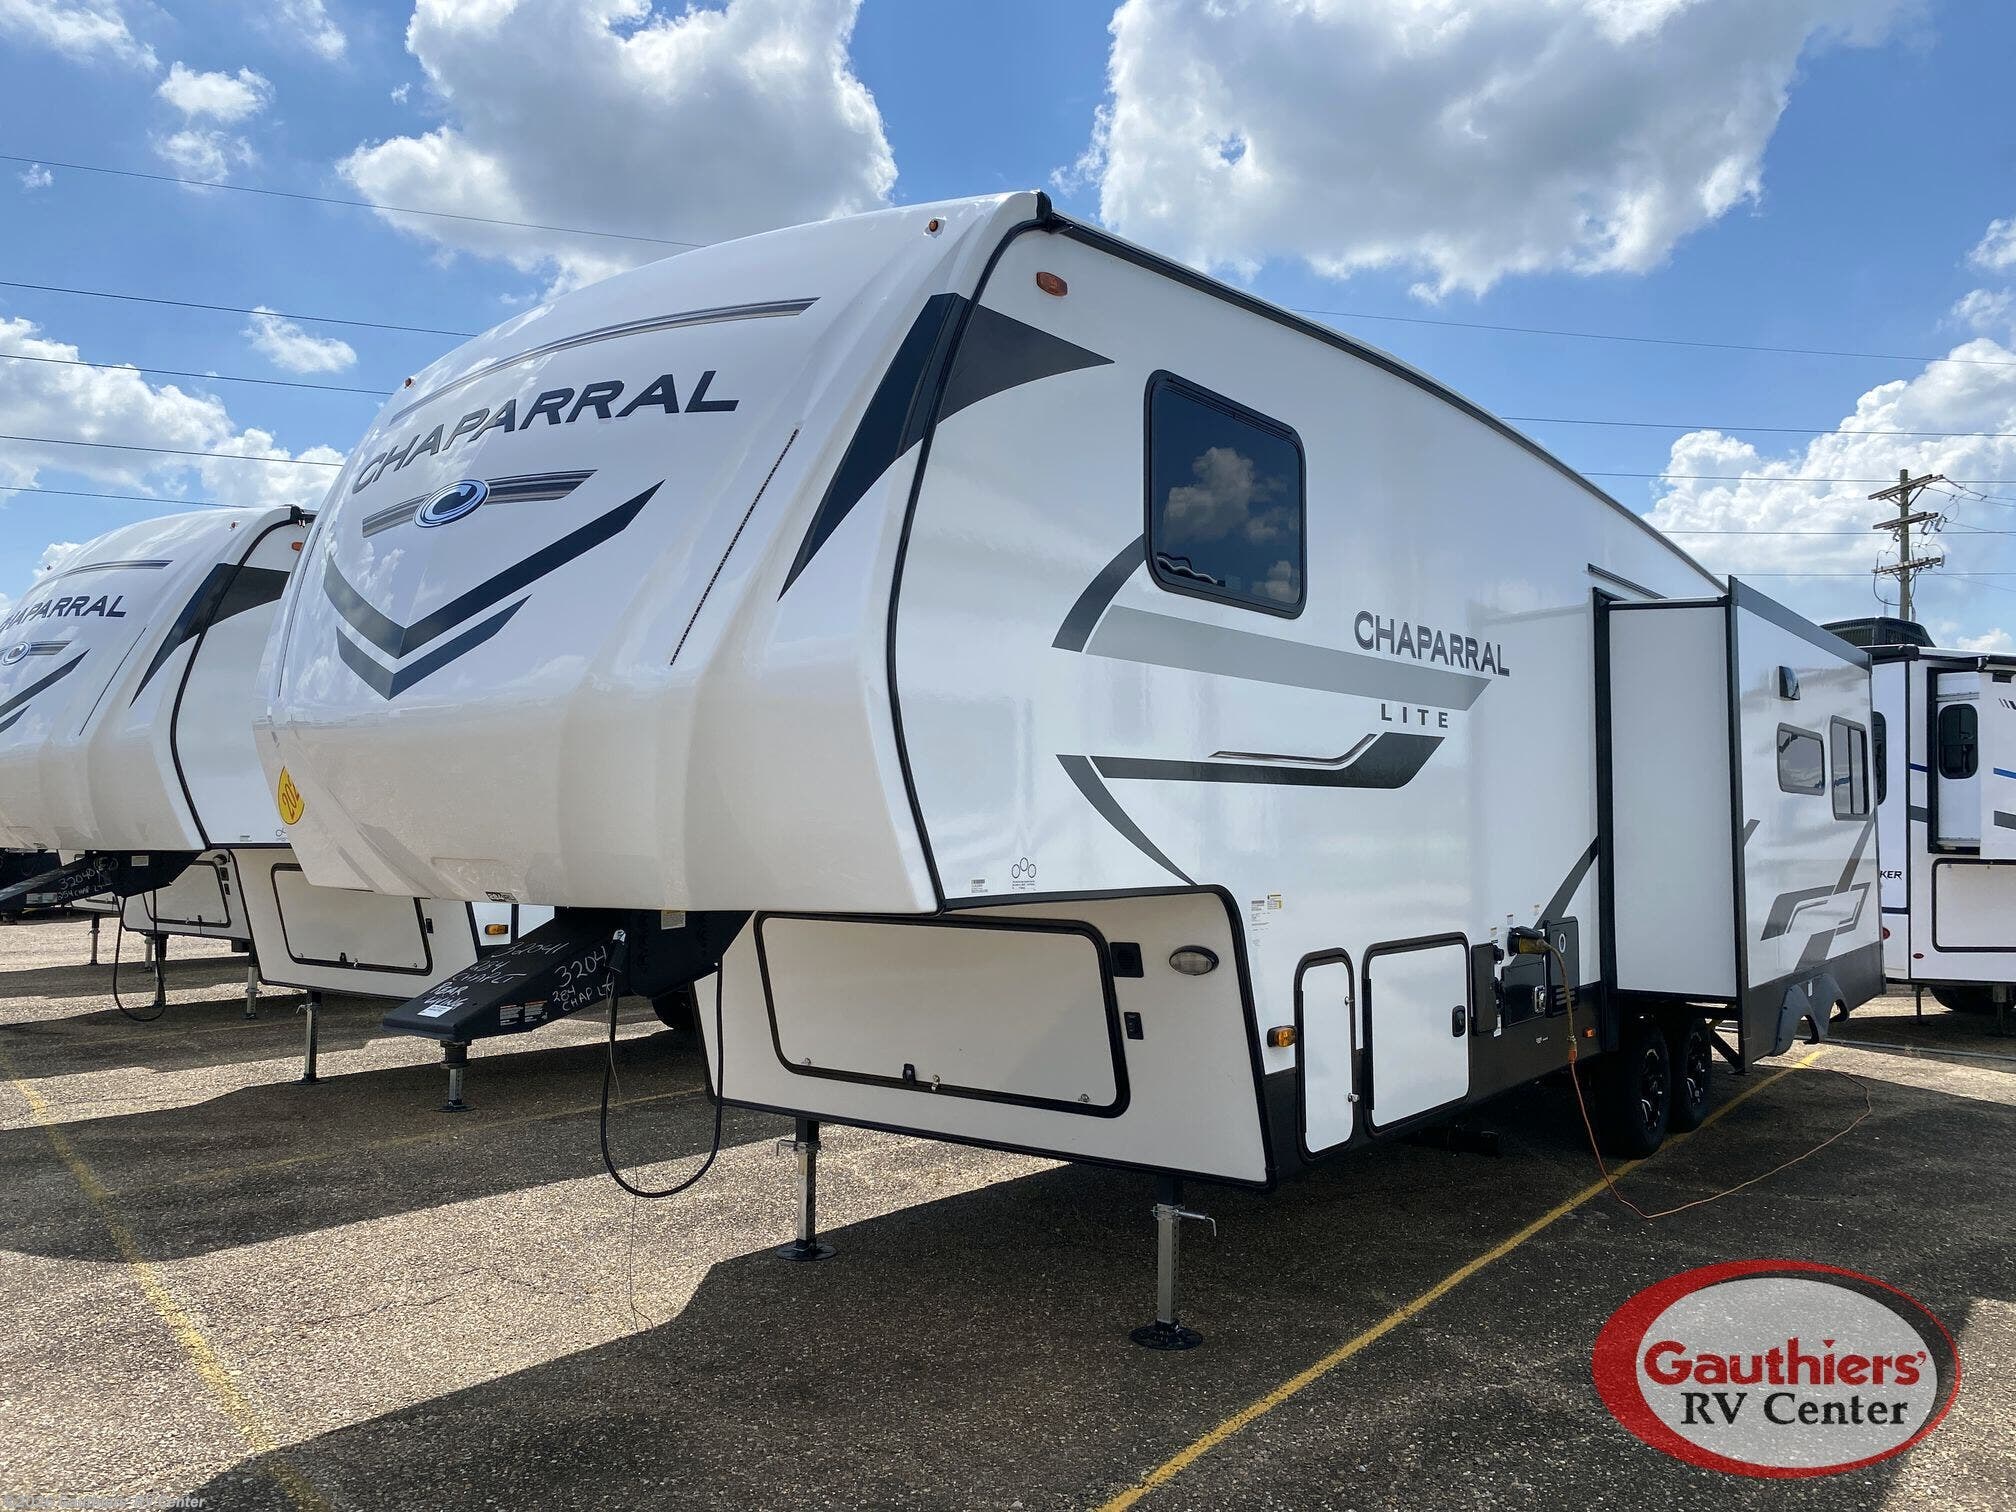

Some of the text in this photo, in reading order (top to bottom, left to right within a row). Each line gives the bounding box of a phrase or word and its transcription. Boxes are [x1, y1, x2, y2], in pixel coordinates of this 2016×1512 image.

[352, 370, 739, 494] CHAPARRAL
[0, 595, 126, 633] HAPARRAL
[1354, 611, 1510, 677] CHAPARRAL
[1381, 703, 1448, 728] LITE
[562, 987, 593, 1012] CHAP
